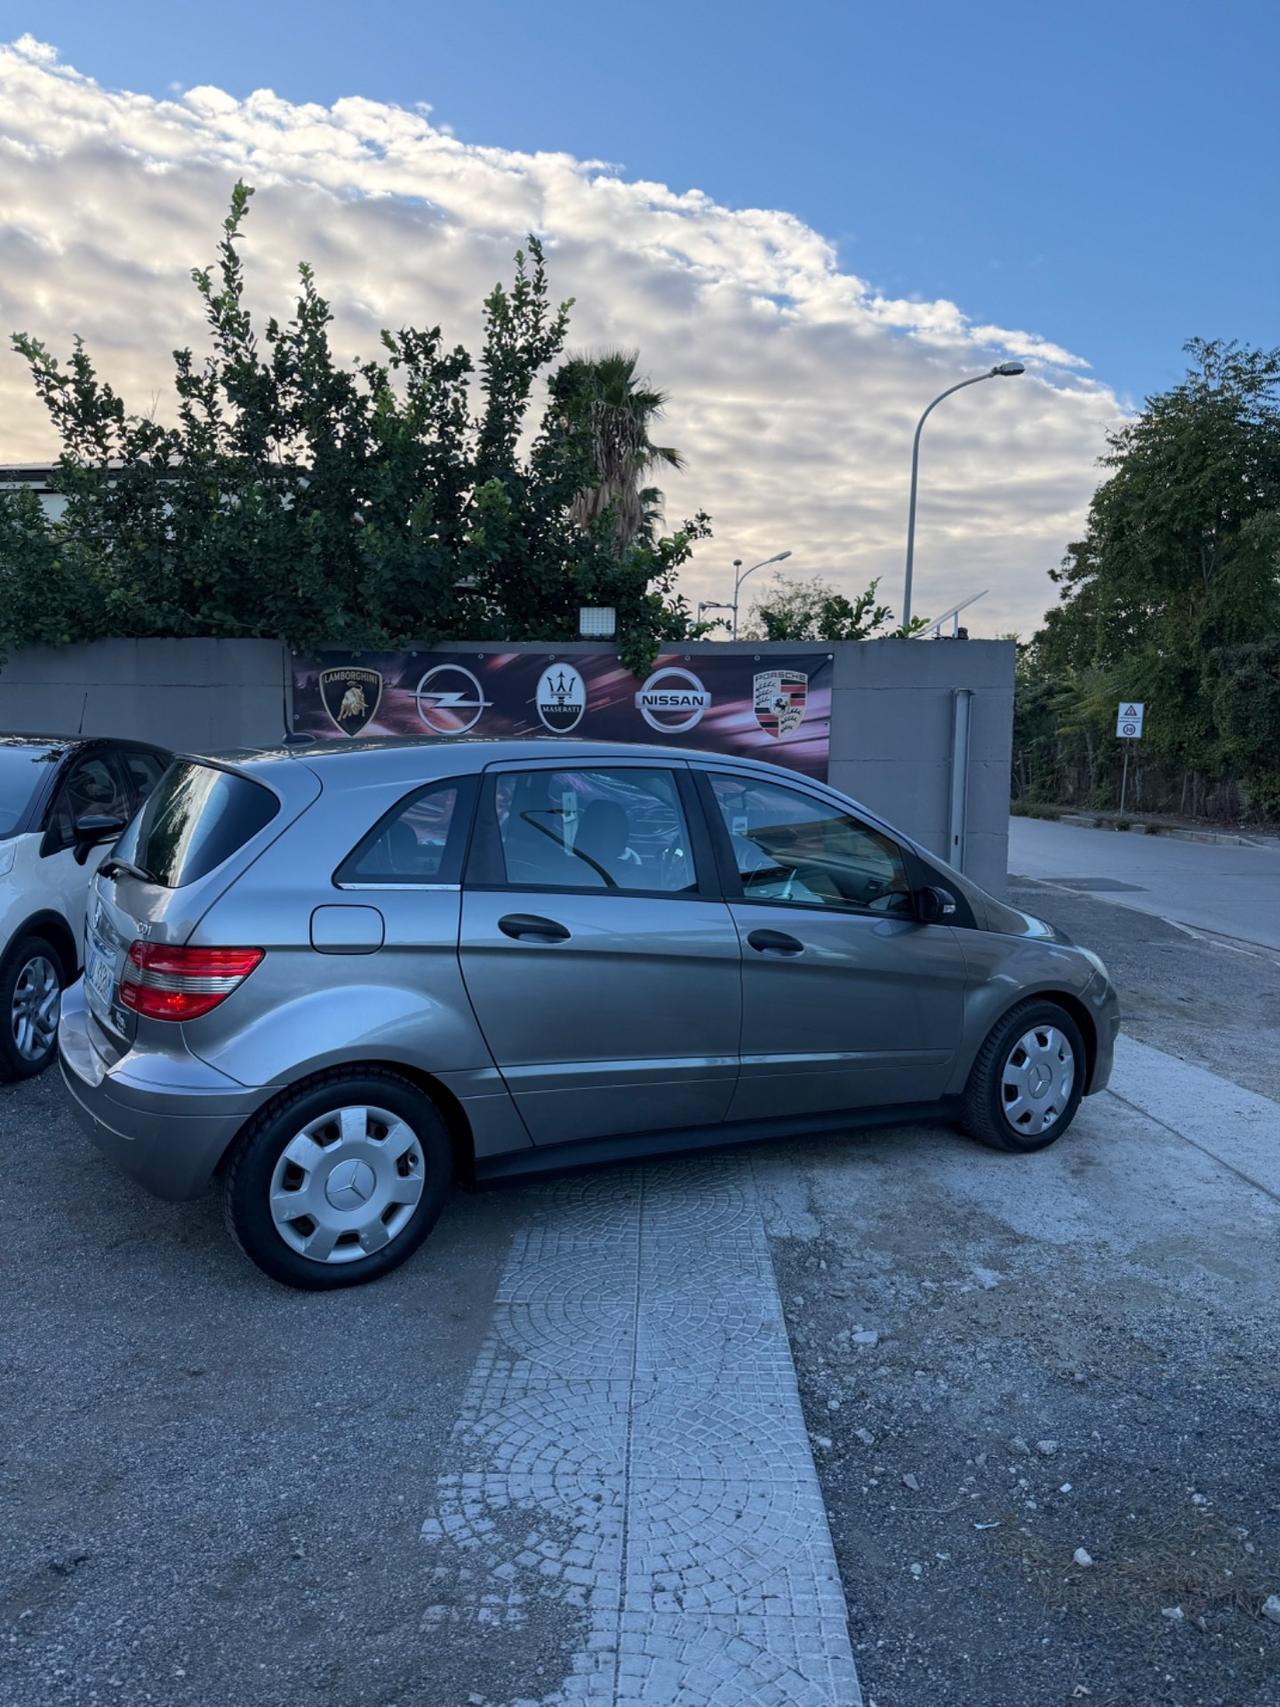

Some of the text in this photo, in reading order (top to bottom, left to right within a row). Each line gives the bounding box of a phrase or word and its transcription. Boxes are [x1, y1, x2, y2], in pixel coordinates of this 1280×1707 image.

[324, 671, 378, 684] LAMBORGHINI
[755, 671, 806, 681] PORSCHE
[642, 695, 704, 706] NISSAN
[542, 705, 580, 713] MASERATI
